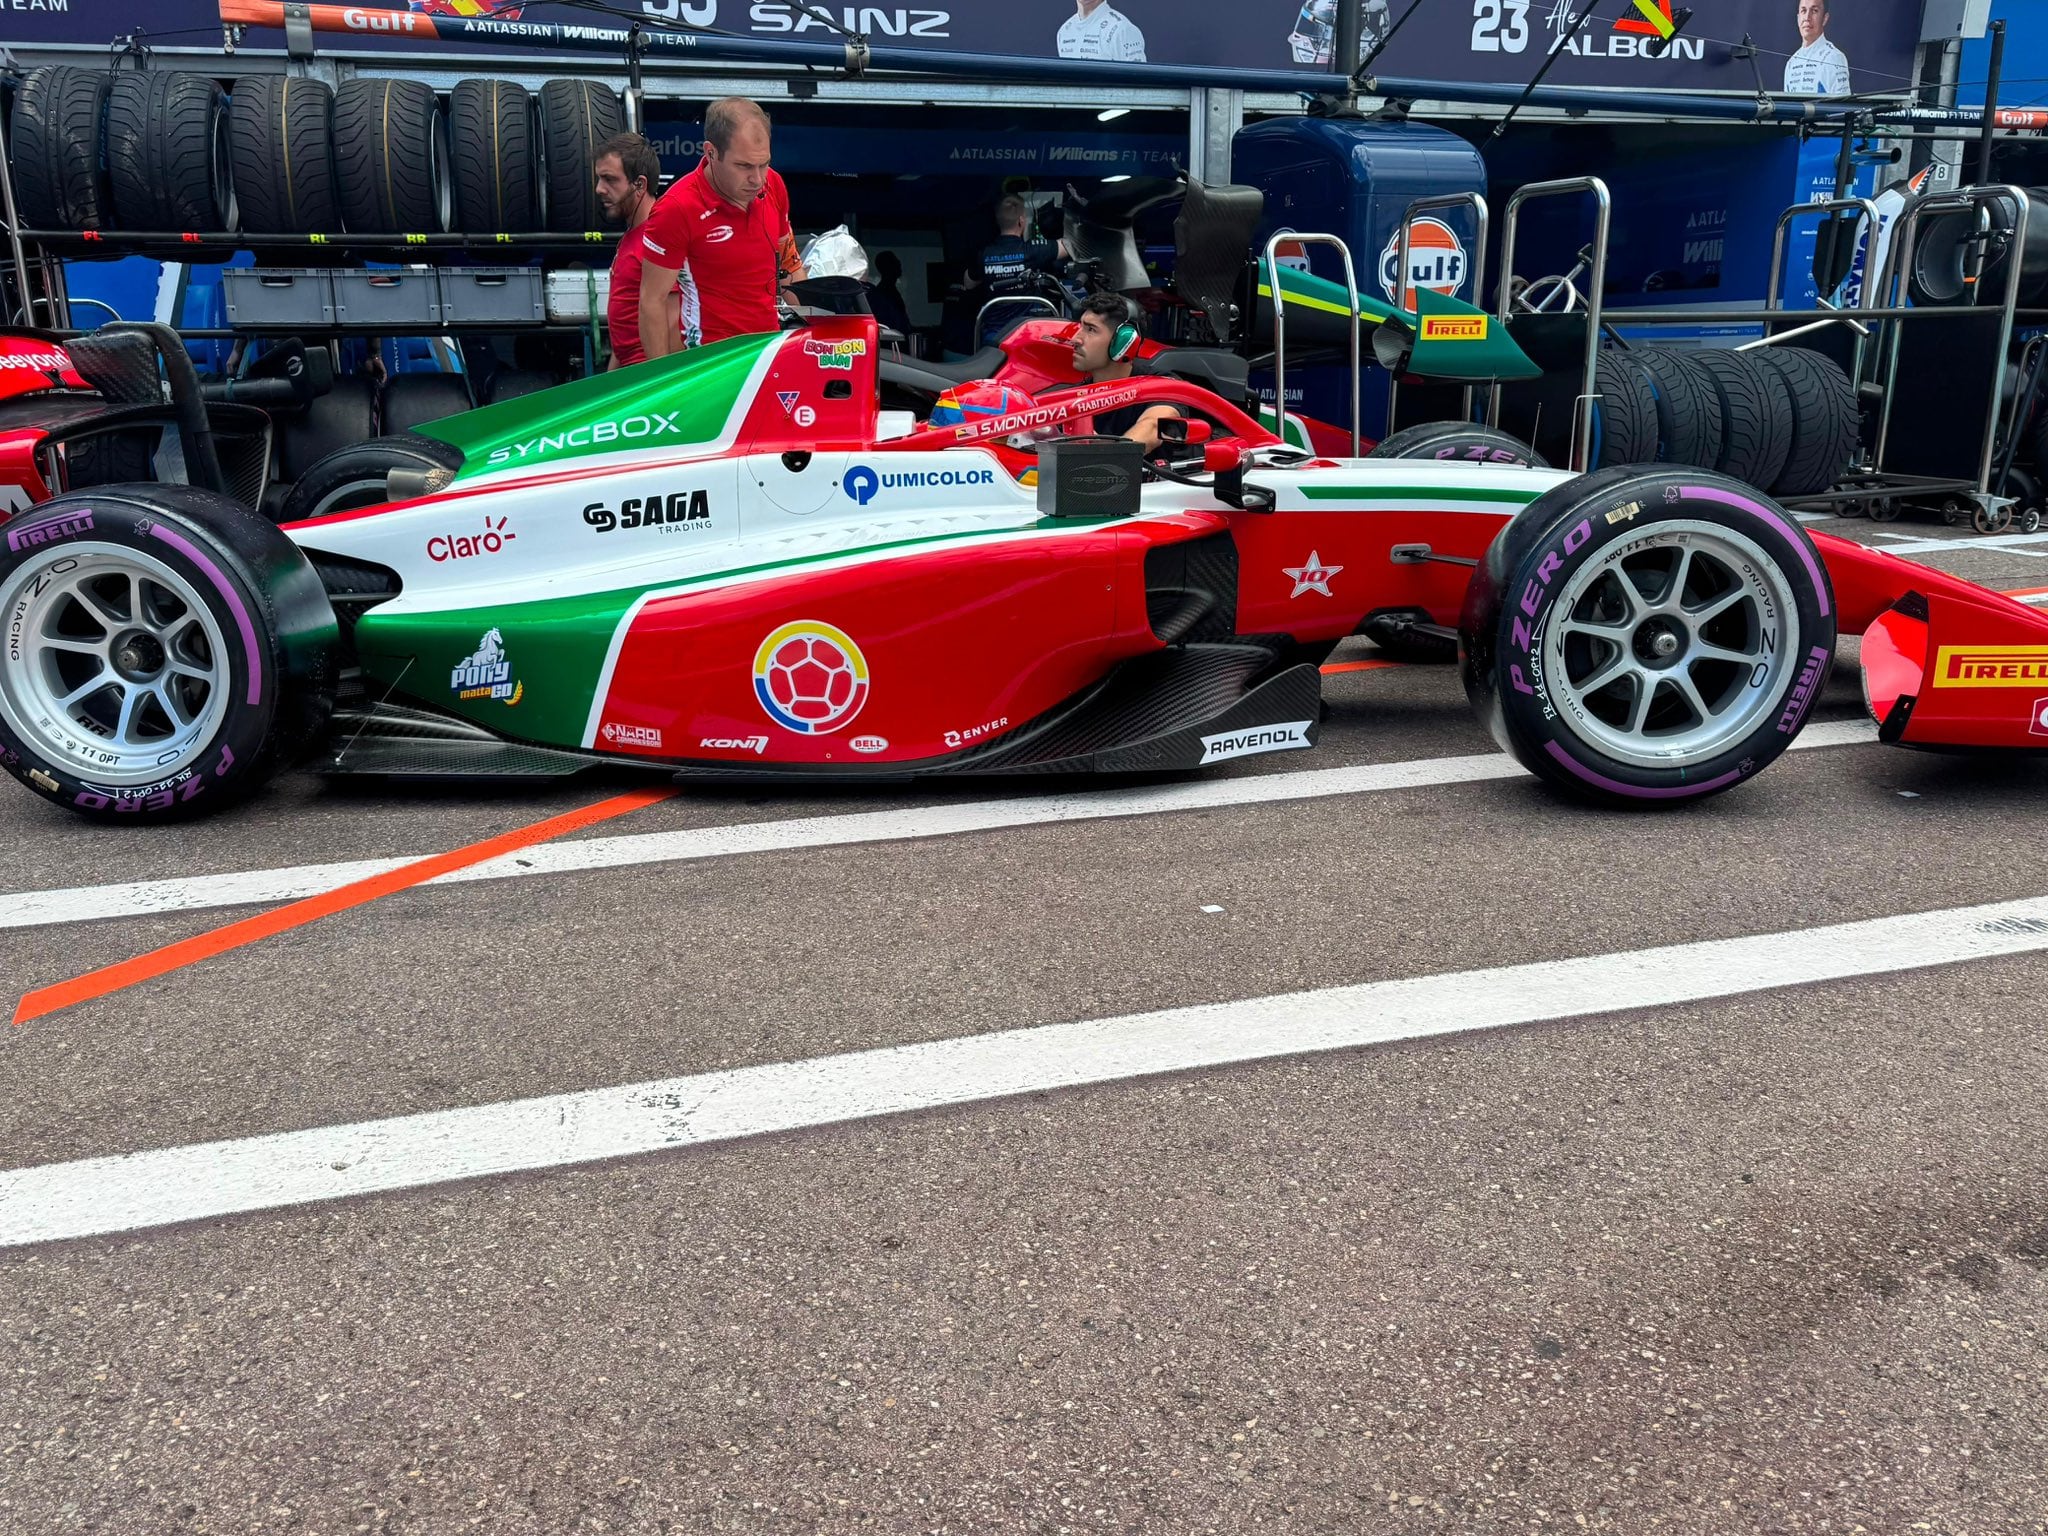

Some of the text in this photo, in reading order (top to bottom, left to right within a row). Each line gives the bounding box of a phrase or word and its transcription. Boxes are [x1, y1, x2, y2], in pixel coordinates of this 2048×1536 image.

[344, 9, 415, 31] Gulf
[750, 4, 950, 38] SAINZ
[1471, 0, 1531, 53] 23
[477, 20, 551, 36] ATLASSIAN
[658, 34, 697, 47] TEAM
[1547, 34, 1705, 60] ALBON
[1911, 108, 1947, 119] Williams
[1959, 111, 1981, 120] TEAM
[2001, 111, 2035, 126] Gulf
[962, 147, 1182, 162] ATLASSIAN Williams F1 TEAM
[1938, 166, 1946, 179] 8
[84, 230, 103, 241] FL
[310, 233, 330, 244] RL
[407, 233, 427, 244] RR
[496, 233, 513, 244] FL
[584, 231, 602, 242] FR
[984, 264, 1025, 274] Williams
[1427, 320, 1482, 335] PIRELLI
[800, 409, 810, 423] E
[980, 406, 1068, 435] S.MONTOYA
[487, 411, 681, 464] SYNCBOX
[621, 489, 710, 529] SAGA
[7, 508, 94, 551] PIRELLI
[657, 521, 712, 534] TRADING
[427, 531, 502, 562] Claro
[1742, 564, 1775, 618] RACING
[1509, 518, 1592, 695] P ZERO
[11, 602, 27, 661] RACING
[1776, 645, 1829, 735] PIRELLI
[76, 715, 109, 735] RR
[855, 740, 883, 748] BELL
[1210, 730, 1299, 755] RAVENOL
[81, 746, 120, 766] 11 OPT
[74, 743, 235, 812] P ZERO
